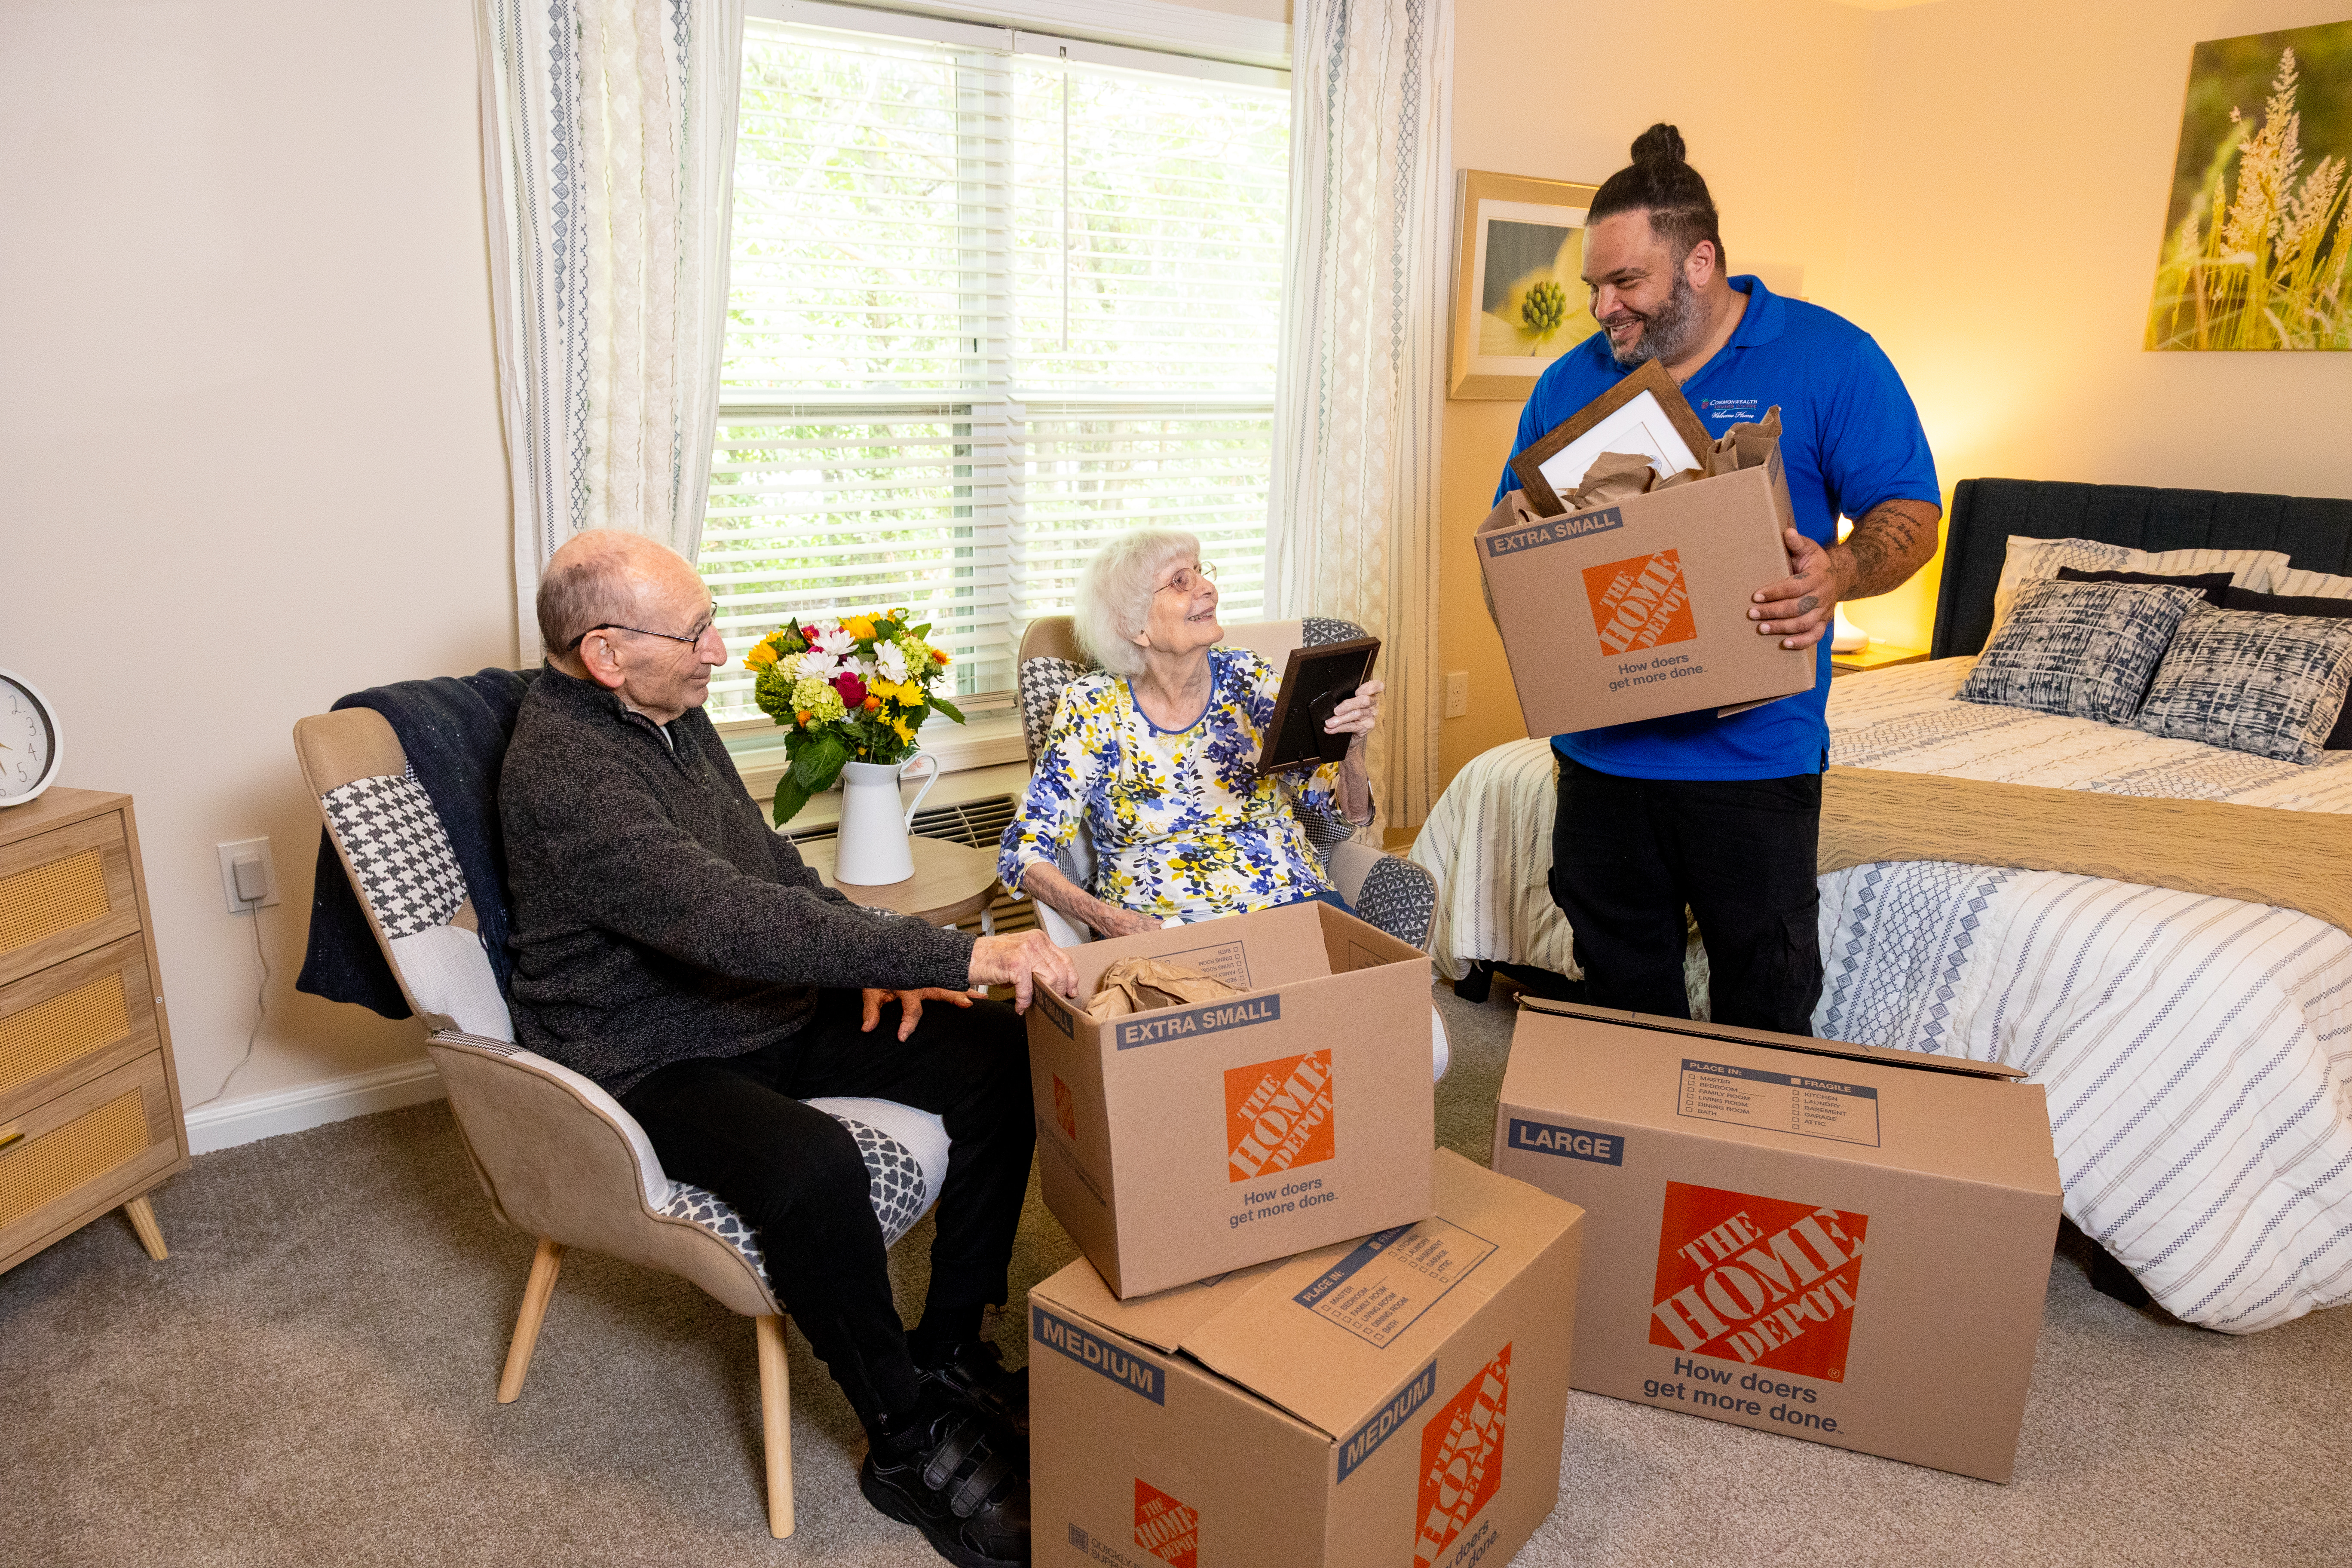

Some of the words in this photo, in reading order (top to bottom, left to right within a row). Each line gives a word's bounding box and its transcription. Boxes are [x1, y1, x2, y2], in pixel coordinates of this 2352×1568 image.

[1712, 410, 1734, 418] Welcome
[1494, 528, 1551, 552] EXTRA
[1555, 513, 1615, 538] SMALL
[1599, 571, 1634, 609] THE
[1599, 552, 1682, 653] HOME
[1637, 584, 1688, 647] DEPOT
[1618, 662, 1647, 675] How
[1651, 655, 1689, 669] doers
[1609, 677, 1630, 692] get
[1633, 672, 1666, 685] more
[1125, 1015, 1197, 1044] EXTRA
[1202, 1001, 1272, 1029] SMALL
[1690, 1062, 1725, 1073] PLACE
[1700, 1076, 1730, 1084] MASTER
[1237, 1073, 1281, 1121] THE
[1700, 1082, 1738, 1092] BEDROOM
[1804, 1080, 1852, 1093] FRAGILE
[1804, 1092, 1838, 1101] KITCHEN
[1229, 1052, 1332, 1178] HOME
[1698, 1102, 1724, 1110] DINING
[1726, 1106, 1750, 1115] ROOM
[1804, 1099, 1841, 1108] LAUNDRY
[1804, 1106, 1847, 1116] BASEMENT
[1804, 1112, 1837, 1121] GARAGE
[1271, 1090, 1333, 1170] DEPOT
[1520, 1125, 1611, 1158] LARGE
[1244, 1189, 1277, 1206] How
[1281, 1178, 1322, 1197] doers
[1229, 1210, 1254, 1229] get
[1258, 1201, 1295, 1219] more
[1396, 1234, 1419, 1252] KITCHEN
[1406, 1237, 1430, 1257] LAUNDRY
[1416, 1240, 1443, 1262] BASEMENT
[1677, 1210, 1764, 1272] THE
[1427, 1250, 1449, 1267] GARAGE
[1437, 1259, 1452, 1272] ATTIC
[1302, 1278, 1333, 1302] PLACE
[1329, 1270, 1345, 1281] IN:
[1652, 1207, 1865, 1352] HOME
[1329, 1286, 1354, 1305] MASTER
[1340, 1287, 1368, 1311] BEDROOM
[1351, 1299, 1371, 1317] FAMILY
[1369, 1286, 1387, 1302] ROOM
[1361, 1306, 1381, 1322] LIVING
[1378, 1292, 1397, 1308] ROOM
[1371, 1311, 1393, 1327] DINING
[1390, 1296, 1409, 1311] ROOM
[1724, 1274, 1856, 1364] DEPOT
[1381, 1320, 1399, 1334] BATH
[1043, 1317, 1153, 1393] MEDIUM
[1673, 1357, 1733, 1385] How
[1740, 1373, 1818, 1404] doers
[1644, 1379, 1687, 1400] get
[1693, 1390, 1762, 1415] more
[1346, 1373, 1430, 1470] MEDIUM
[1414, 1354, 1510, 1564] HOME
[1426, 1407, 1467, 1487] THE
[1450, 1403, 1505, 1533] DEPOT
[1140, 1498, 1167, 1518] THE
[1135, 1506, 1198, 1550] HOME
[1455, 1520, 1488, 1565] doers
[1091, 1537, 1131, 1567] QUICKLY
[1159, 1533, 1198, 1562] DEPOT
